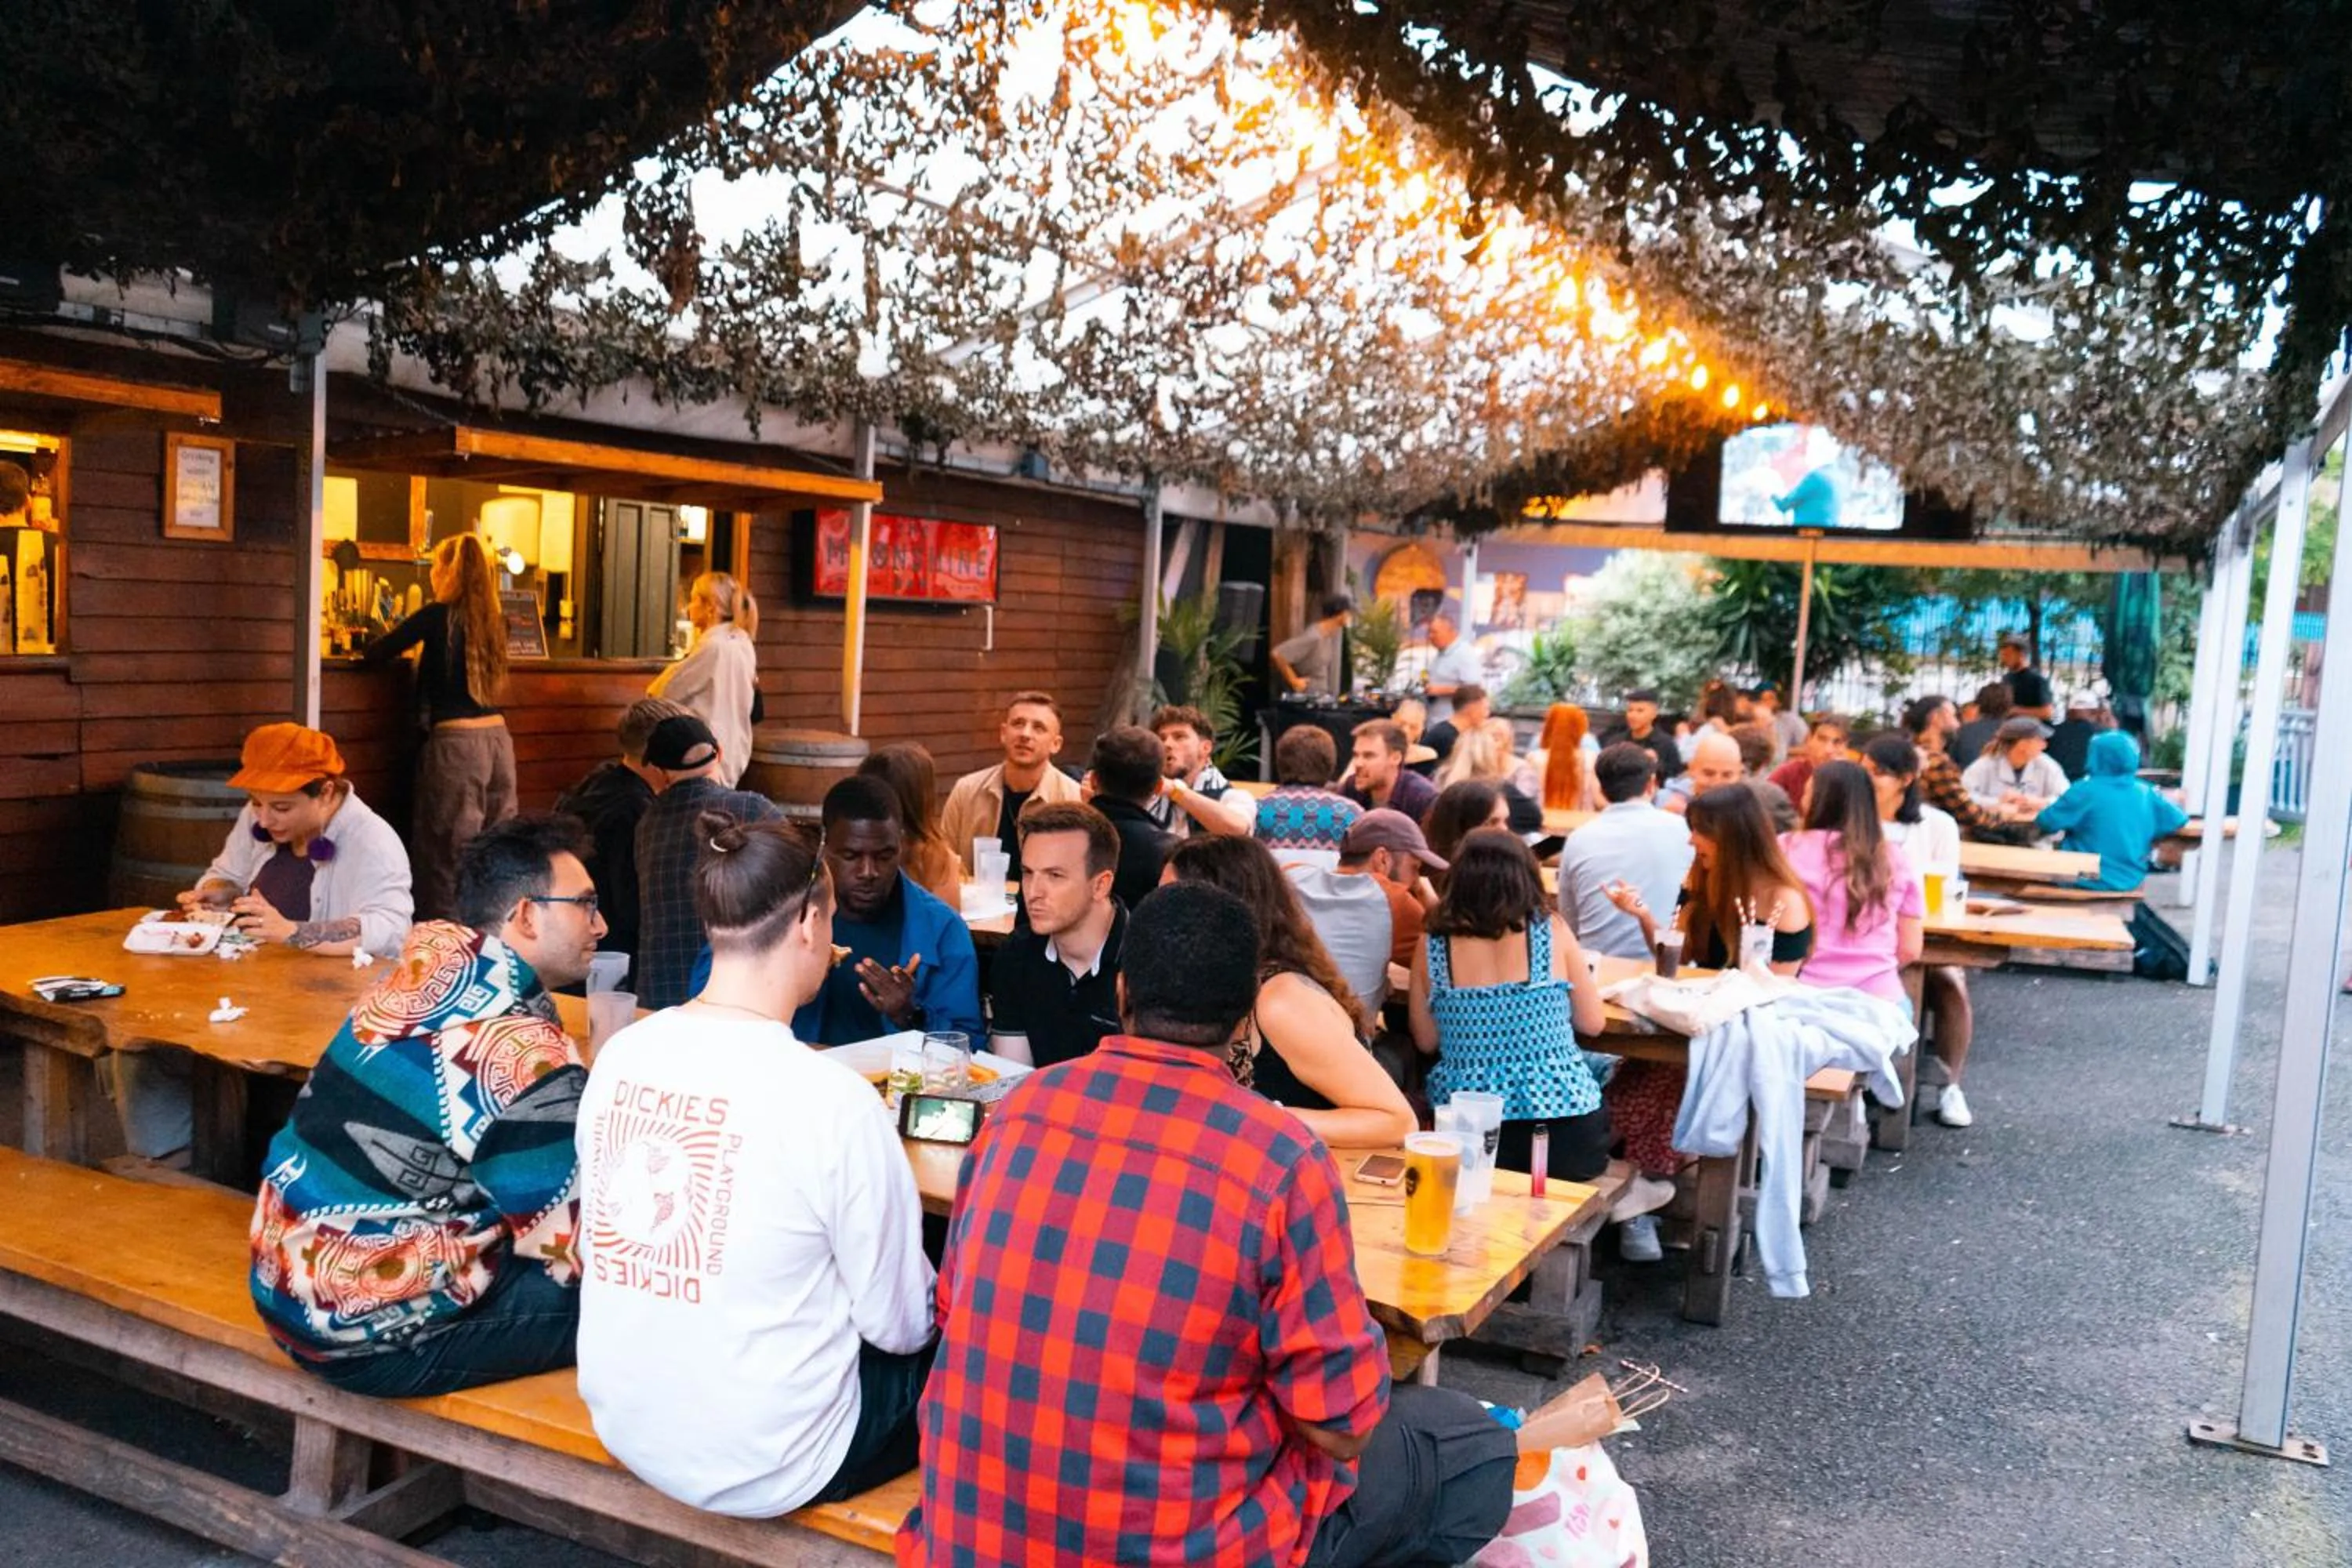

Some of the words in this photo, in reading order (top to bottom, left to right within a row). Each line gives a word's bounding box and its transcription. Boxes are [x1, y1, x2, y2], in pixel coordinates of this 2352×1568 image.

[826, 535, 989, 577] MONSHINE
[615, 1080, 729, 1125] DICKIES
[707, 1134, 742, 1276] PLAYGROUND
[594, 1254, 700, 1303] DICKIES
